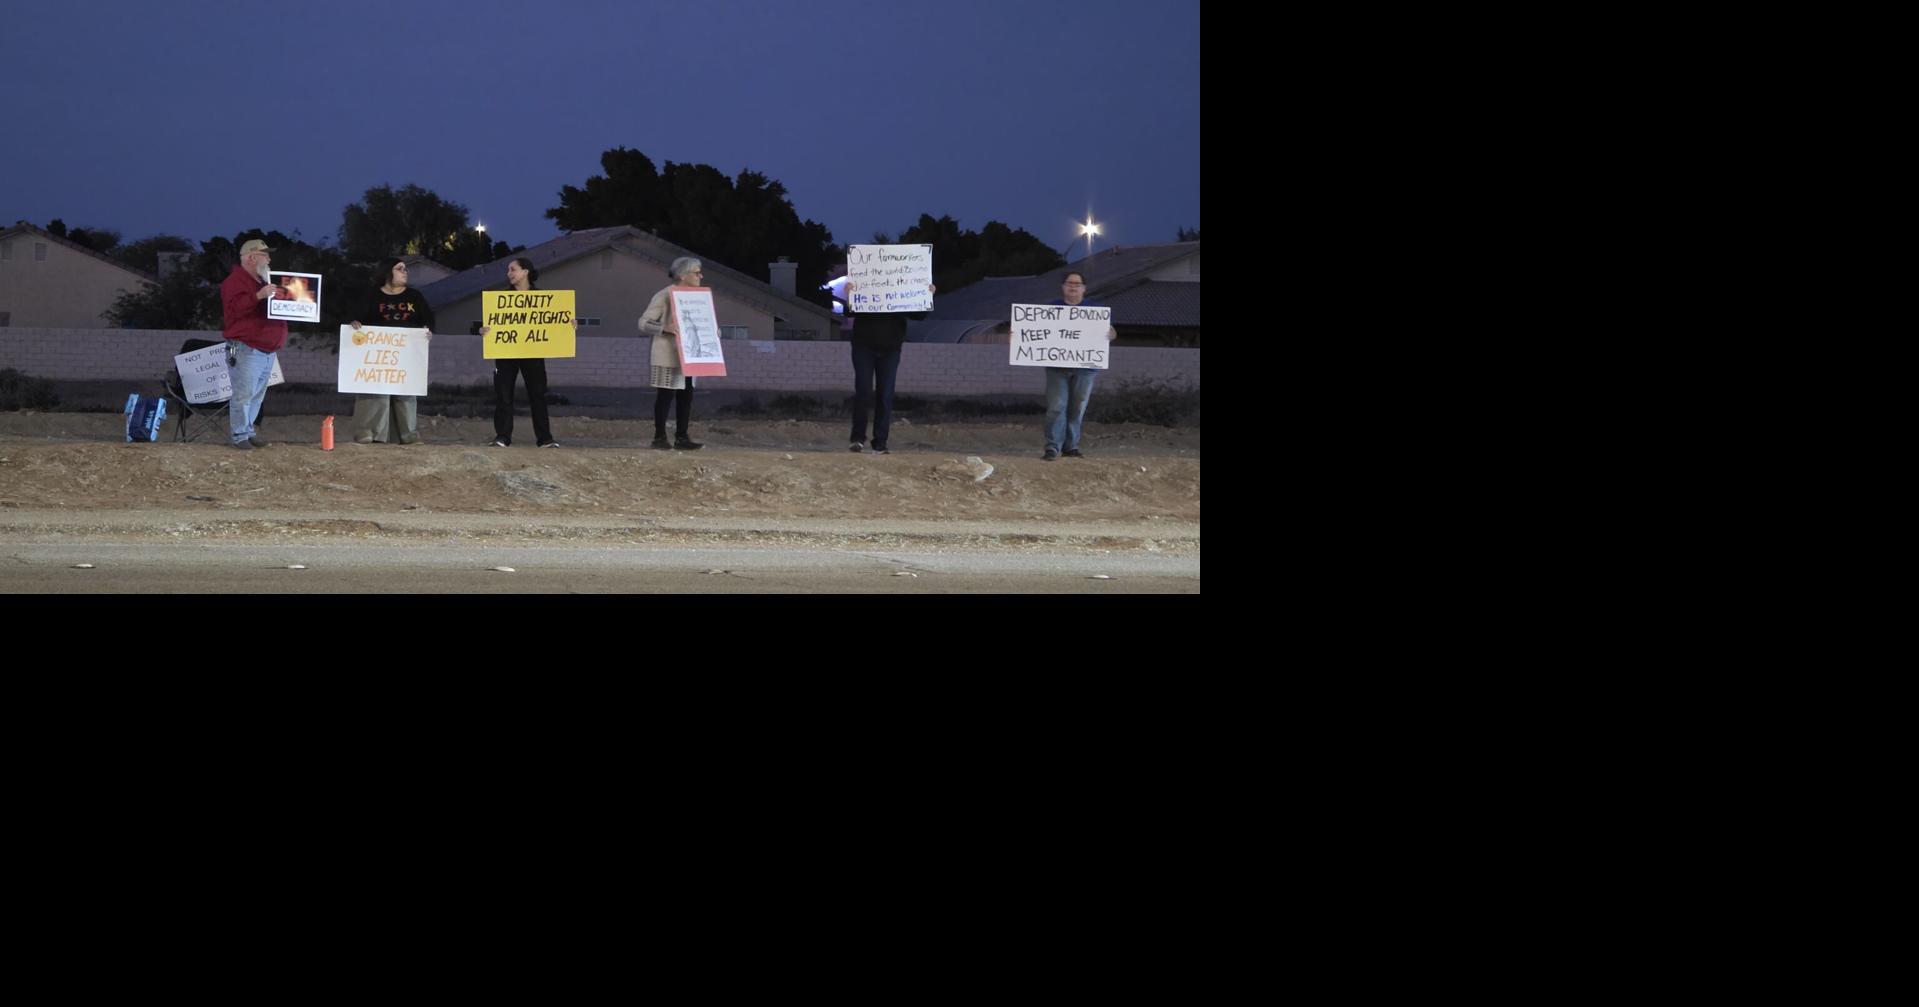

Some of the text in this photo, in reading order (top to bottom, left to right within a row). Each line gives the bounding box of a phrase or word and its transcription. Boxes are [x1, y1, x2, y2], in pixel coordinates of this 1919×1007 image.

[850, 247, 872, 264] Our
[850, 267, 868, 277] feed
[870, 267, 882, 276] the
[497, 294, 554, 309] DIGNITY
[854, 294, 868, 303] He
[872, 294, 881, 302] is
[885, 291, 897, 300] not
[273, 302, 313, 313] DEMOCRACY
[1014, 305, 1110, 321] DEPORT BOVINO
[488, 310, 571, 326] HUMAN RIGHTS
[495, 329, 549, 344] FOR ALL
[1021, 328, 1081, 342] KEEP THE
[185, 353, 202, 364] NOT
[364, 349, 400, 366] LIES
[1016, 346, 1105, 362] MIGRANTS
[195, 360, 220, 374] LEGAL
[206, 374, 217, 384] OF
[354, 367, 407, 385] MATTER
[194, 388, 218, 401] RISKS
